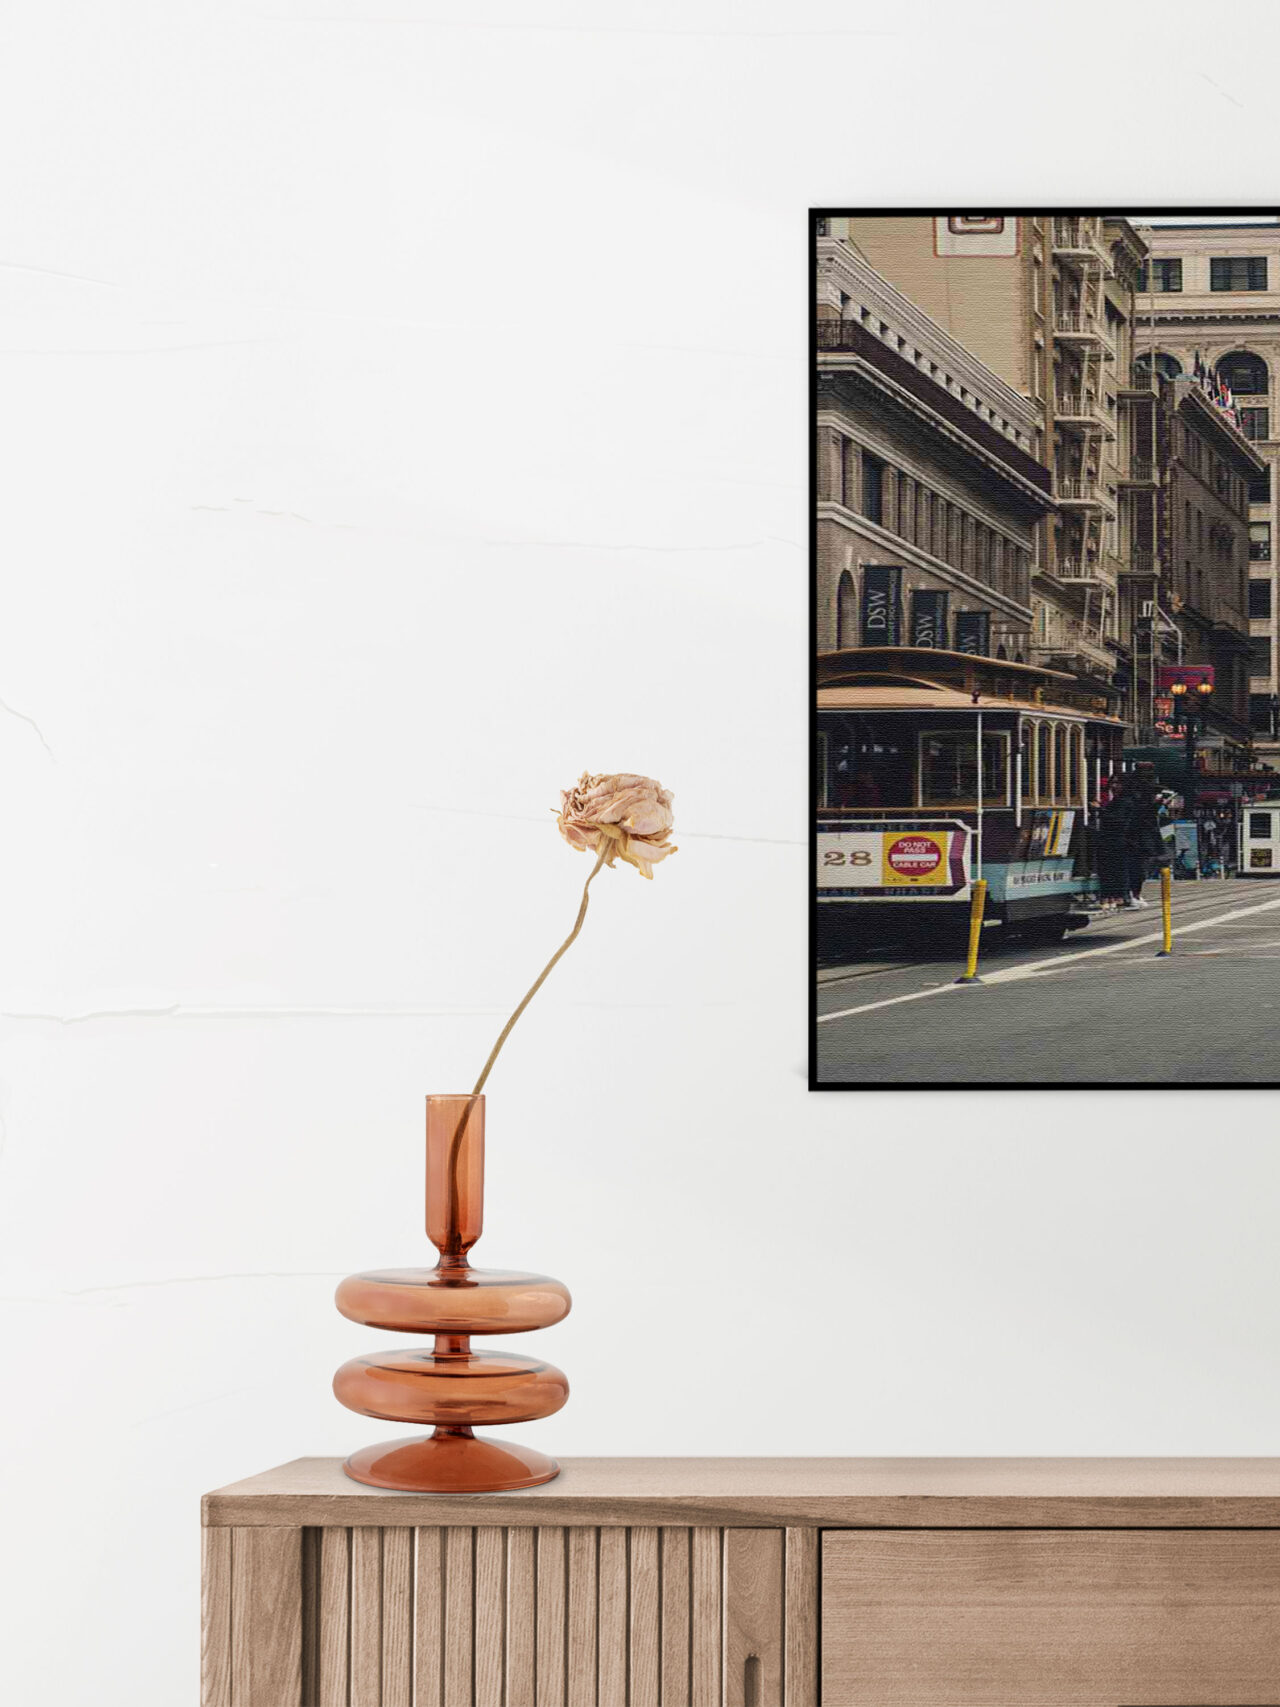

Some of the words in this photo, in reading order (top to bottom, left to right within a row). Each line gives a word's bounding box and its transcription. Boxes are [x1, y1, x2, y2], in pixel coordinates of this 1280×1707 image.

[867, 589, 886, 629] DSW
[898, 841, 912, 849] DO
[913, 841, 931, 849] NOT
[823, 851, 873, 867] 28
[893, 861, 918, 869] CABLE
[919, 861, 937, 869] CAR
